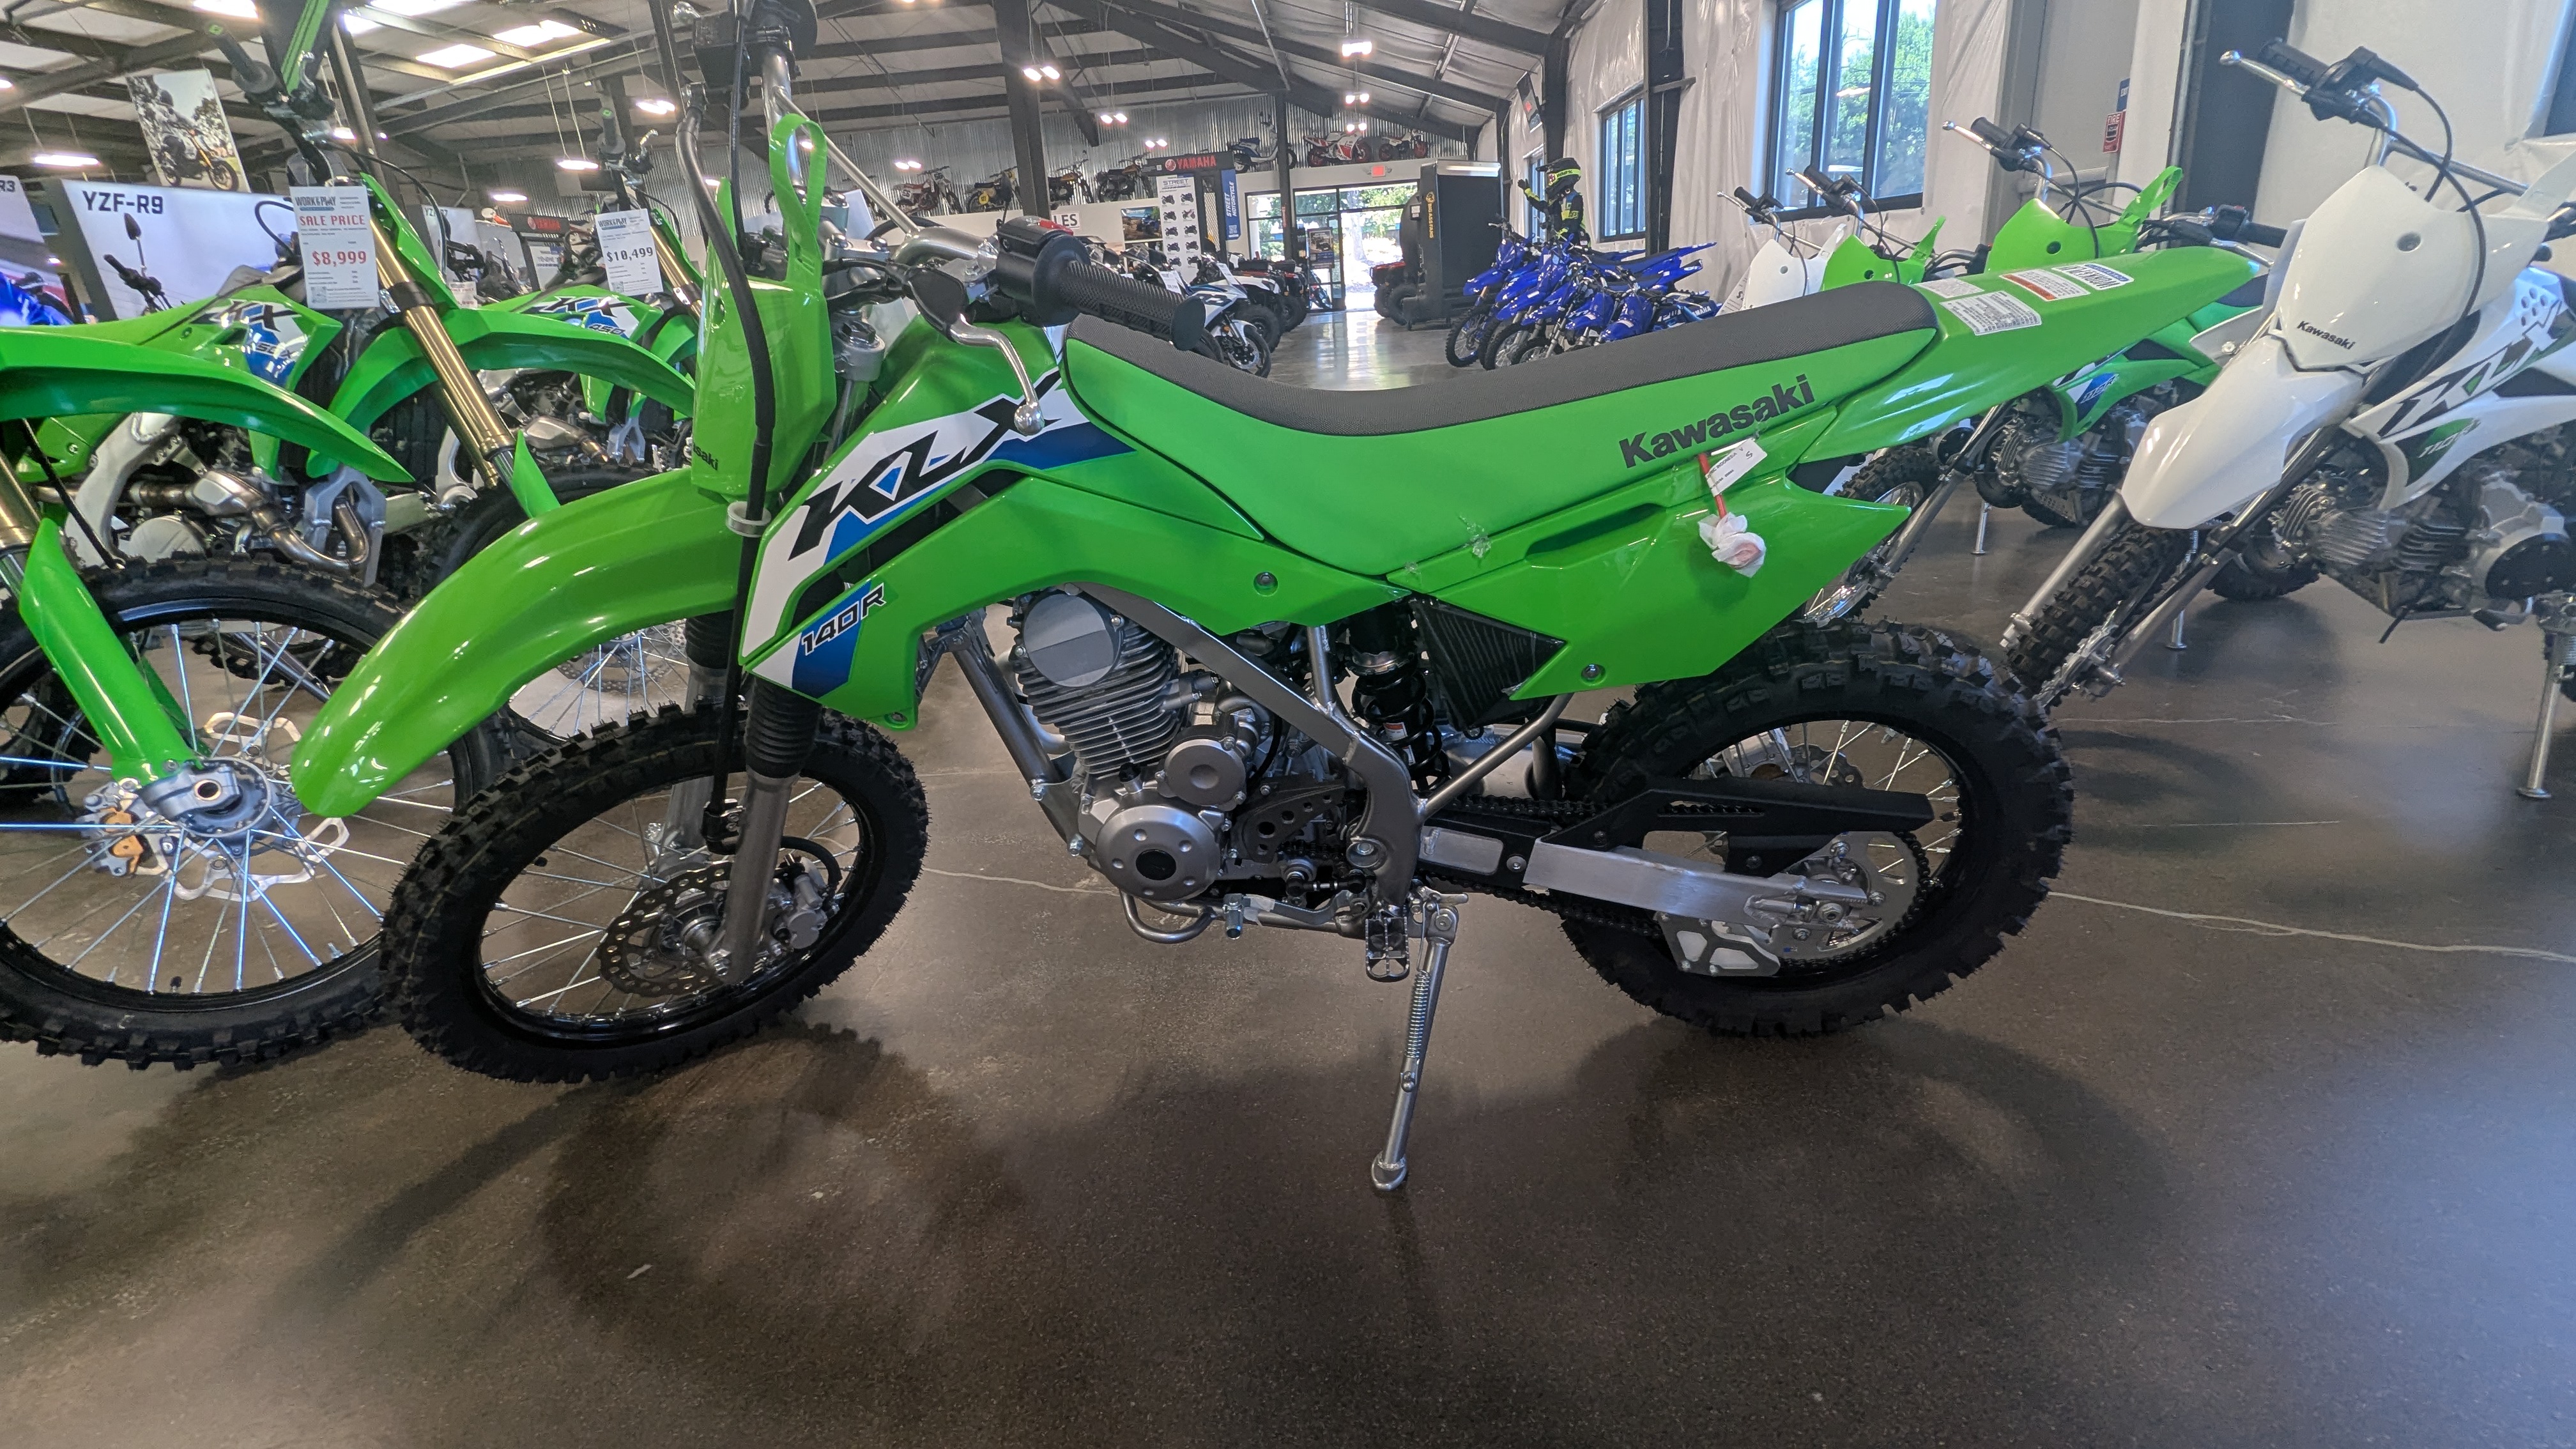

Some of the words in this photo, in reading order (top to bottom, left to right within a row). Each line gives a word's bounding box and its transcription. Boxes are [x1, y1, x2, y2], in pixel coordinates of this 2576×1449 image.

[1177, 156, 1216, 169] YAMAHA
[82, 190, 164, 215] YZF-R9
[299, 215, 327, 226] SALE
[330, 215, 366, 226] PRICE
[312, 250, 367, 267] $8,999
[606, 247, 654, 263] $10,499
[2296, 321, 2356, 350] Kawasaki
[1618, 373, 1815, 469] Kawasaki
[788, 370, 1062, 562] KLX
[802, 582, 887, 656] 140R
